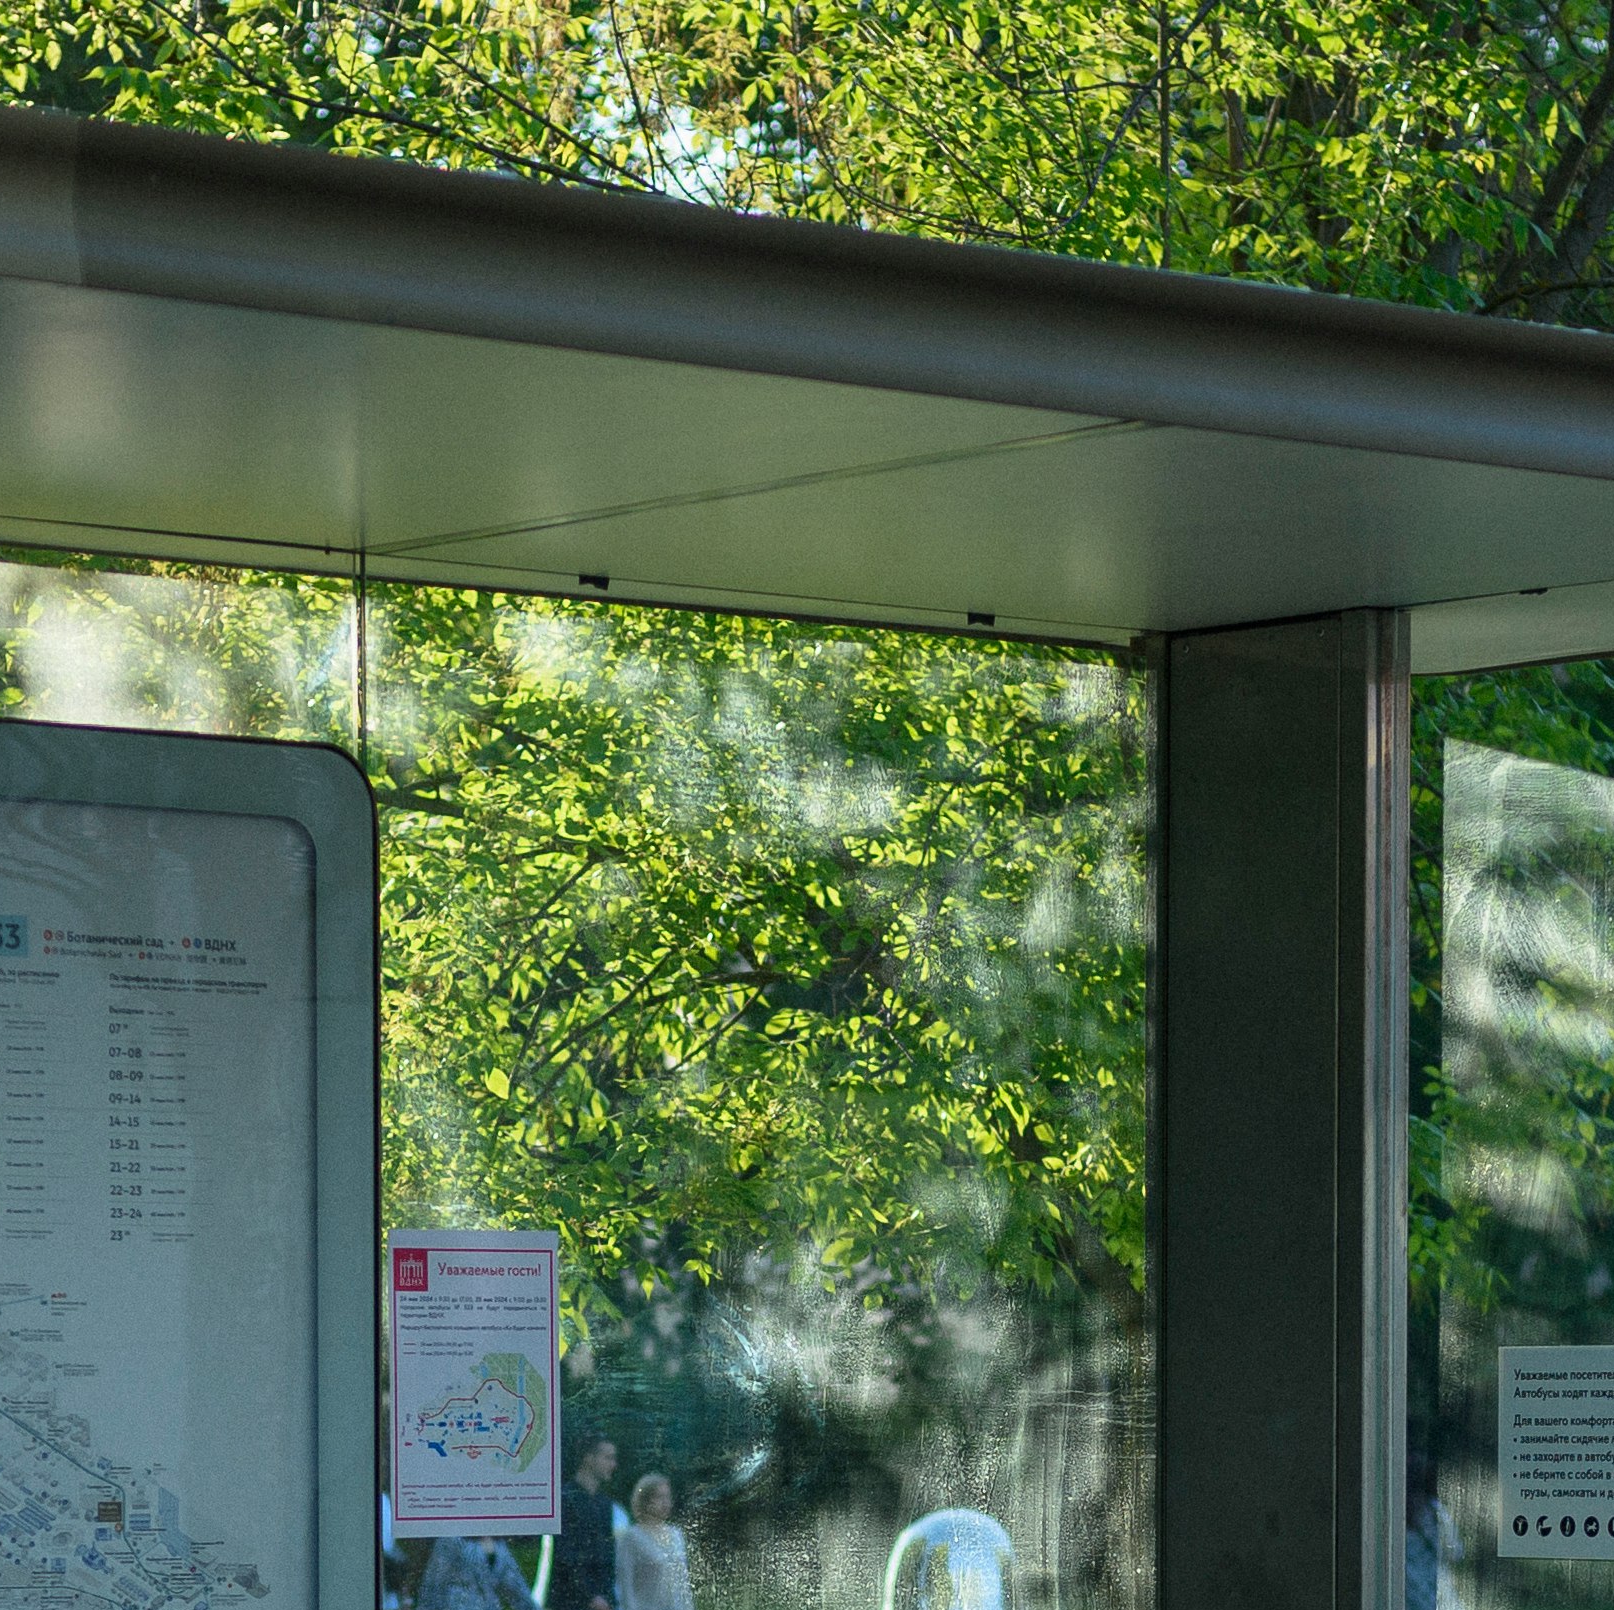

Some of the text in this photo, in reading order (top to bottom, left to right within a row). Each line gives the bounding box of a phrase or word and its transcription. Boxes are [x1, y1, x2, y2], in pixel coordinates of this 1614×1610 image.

[437, 1261, 542, 1277] Уважаемые гости!
[399, 1277, 424, 1287] ВДНХ
[1514, 1368, 1568, 1381] Уважаемые
[1513, 1386, 1560, 1401] Автобусы
[1561, 1389, 1588, 1400] ходят
[1513, 1414, 1532, 1428] Для
[1534, 1417, 1568, 1426] вашего
[1520, 1434, 1569, 1444] занимайте
[1571, 1436, 1609, 1446] сидячие
[1520, 1453, 1531, 1462] не
[1533, 1453, 1575, 1464] заходите
[1577, 1453, 1583, 1462] в
[1520, 1471, 1530, 1480] не
[1533, 1468, 1565, 1482] берите
[1567, 1471, 1573, 1480] с
[1575, 1468, 1603, 1480] собой
[1605, 1471, 1611, 1480] в
[1520, 1489, 1550, 1500] грузы,
[1552, 1489, 1597, 1498] самокаты
[1599, 1489, 1606, 1498] и
